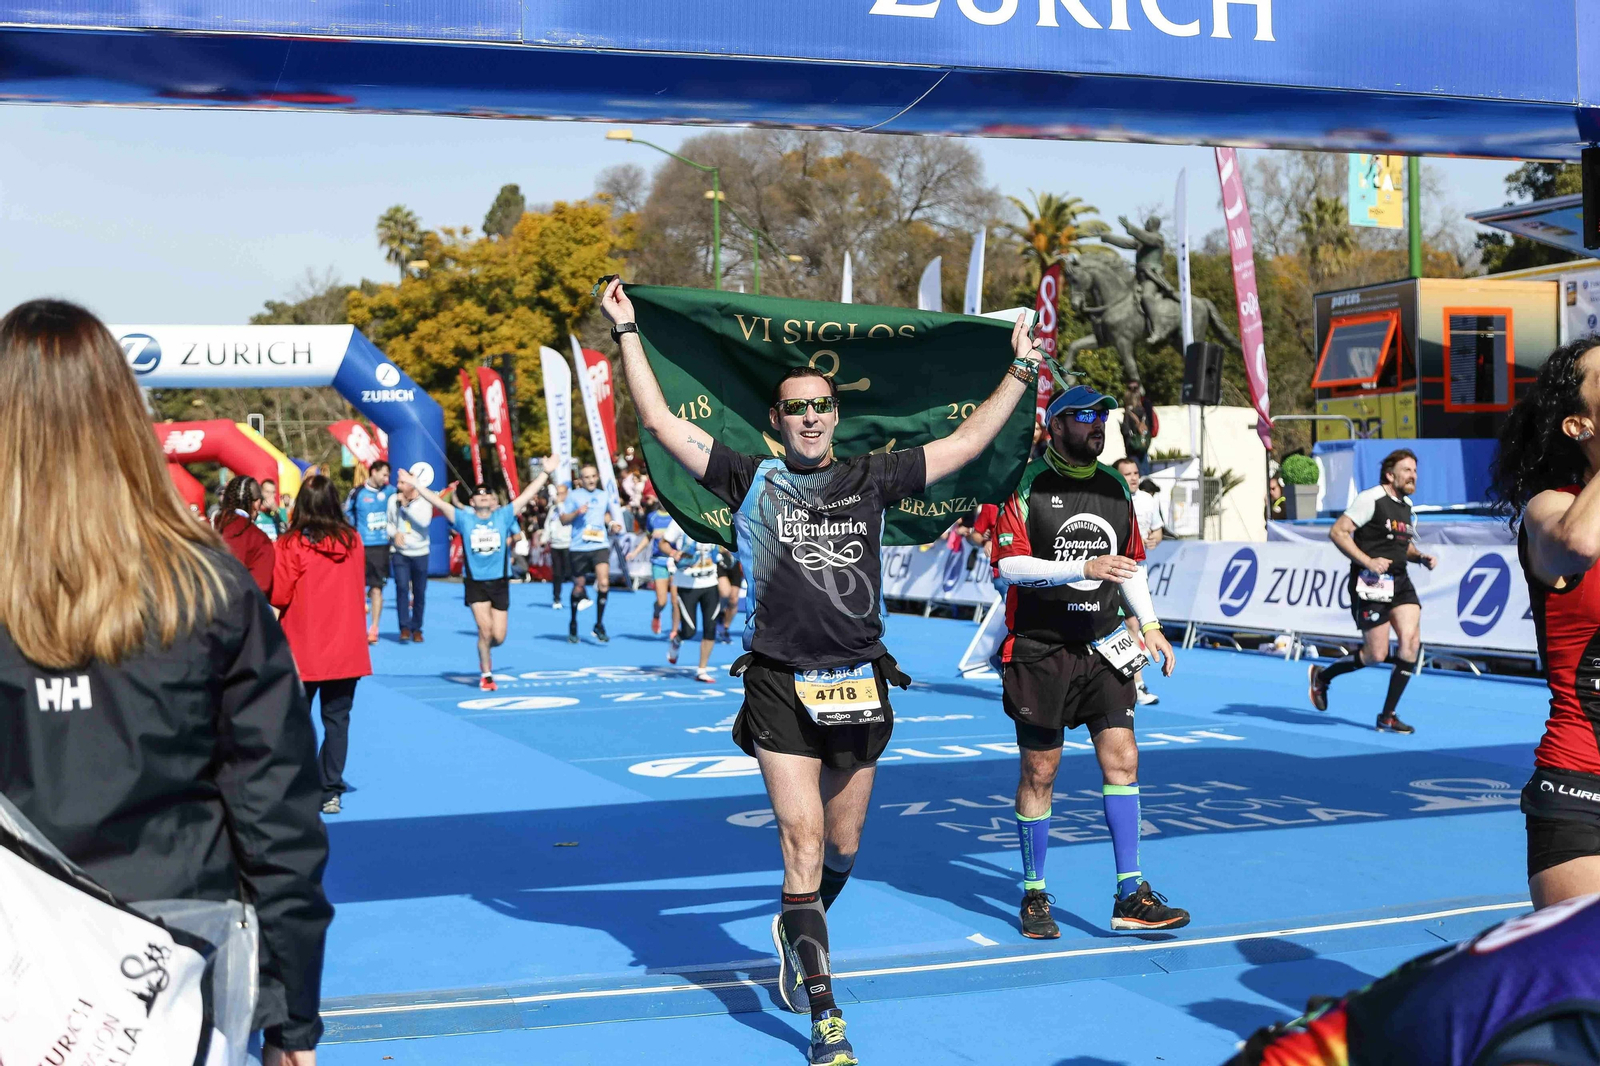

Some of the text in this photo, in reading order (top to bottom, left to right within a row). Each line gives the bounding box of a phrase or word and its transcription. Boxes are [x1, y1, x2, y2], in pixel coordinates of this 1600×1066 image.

[734, 314, 915, 344] VI SIGLOS
[181, 341, 313, 365] ZURICH
[361, 389, 415, 403] ZURICH
[668, 395, 976, 420] 418 20
[554, 393, 570, 467] ZURICH
[784, 505, 809, 522] Los
[898, 496, 979, 517] ERANZA
[776, 516, 868, 545] Legendarios
[1053, 535, 1109, 550] Donando
[882, 552, 912, 580] ICH
[1147, 562, 1176, 597] CH
[1263, 567, 1351, 610] ZURIC
[1067, 600, 1100, 612] mobel
[821, 667, 864, 680] ZURICH
[35, 674, 93, 712] HH
[815, 686, 857, 701] 4718
[38, 998, 93, 1066] URICH
